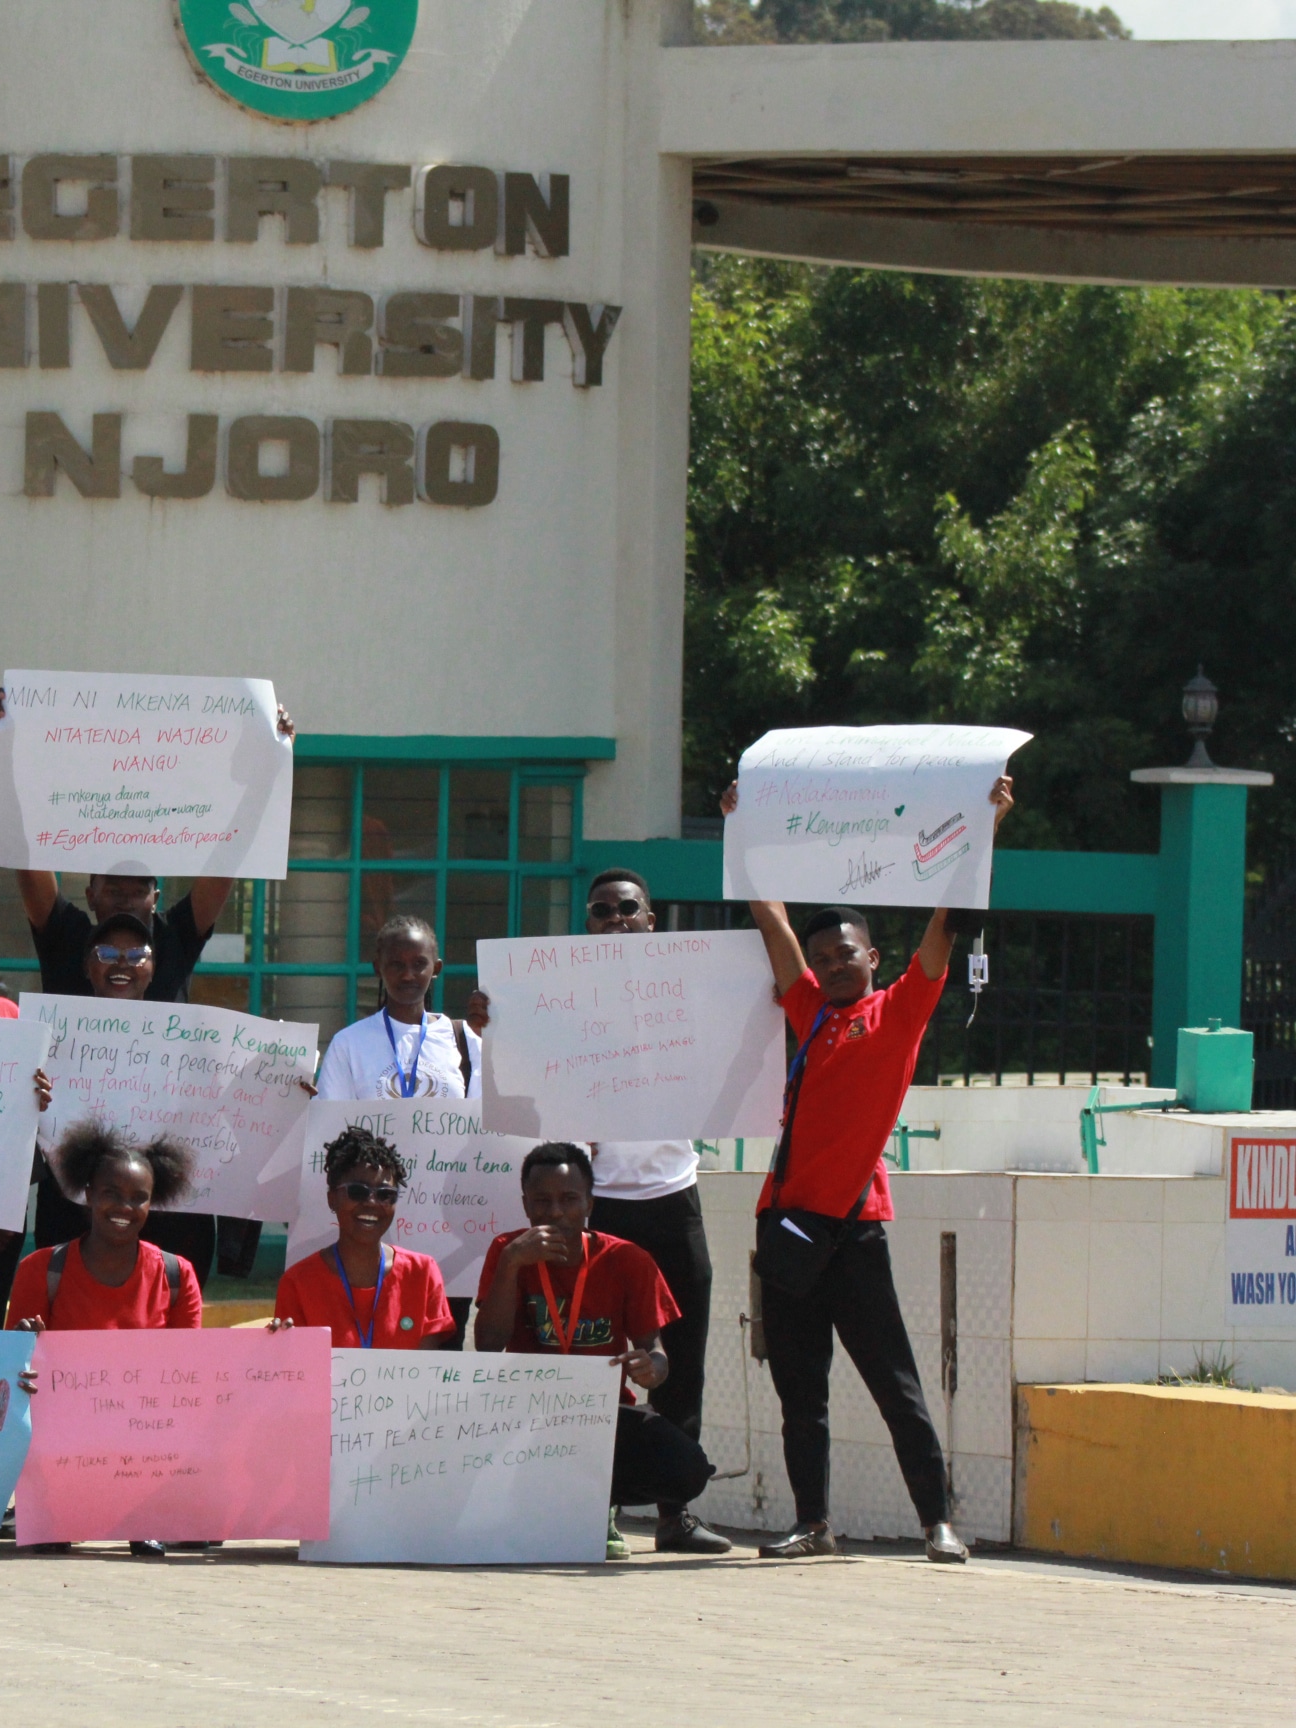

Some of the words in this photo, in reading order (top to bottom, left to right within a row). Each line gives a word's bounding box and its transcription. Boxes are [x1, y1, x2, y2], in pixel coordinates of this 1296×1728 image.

[237, 65, 292, 89] EGERTON
[295, 69, 362, 90] UNIVERSITY
[22, 410, 501, 507] NJORO
[5, 686, 57, 709] MIMI
[73, 690, 97, 710] NI
[116, 692, 191, 713] MKENYA
[201, 694, 256, 717] DAIMA
[44, 726, 141, 746] NITATENDA
[157, 726, 228, 746] WAJIBU
[754, 748, 796, 769] And
[786, 809, 891, 847] #Kenyamoja
[528, 948, 558, 973] AM
[570, 943, 624, 967] KEITH
[644, 938, 713, 958] CLINTON
[534, 991, 575, 1015] And
[77, 1015, 131, 1035] name
[161, 1013, 222, 1044] Bosire
[177, 1049, 245, 1081] peaceful
[162, 1071, 223, 1100] friends
[232, 1083, 267, 1106] and
[129, 1103, 184, 1125] person
[425, 1148, 468, 1174] damu
[432, 1185, 489, 1207] violence
[1231, 1272, 1275, 1305] WASH
[50, 1369, 112, 1393] POWER
[122, 1368, 143, 1385] OF
[160, 1369, 201, 1385] LOVE
[244, 1367, 306, 1383] GREATER
[377, 1366, 420, 1380] INTO
[428, 1366, 461, 1384] THE
[472, 1366, 574, 1384] ELECTROL
[90, 1397, 126, 1414] THAN
[138, 1396, 160, 1408] THE
[172, 1396, 203, 1408] LOVE
[405, 1389, 470, 1422] WITH
[479, 1392, 516, 1412] THE
[526, 1390, 608, 1416] MINDSET
[128, 1417, 175, 1431] POWER
[384, 1424, 445, 1450] PEACE
[457, 1418, 522, 1441] MEANS
[529, 1412, 613, 1432] EVERYTHING
[390, 1460, 448, 1490] PEACE
[462, 1453, 493, 1473] FOR
[502, 1444, 578, 1466] COMRADE
